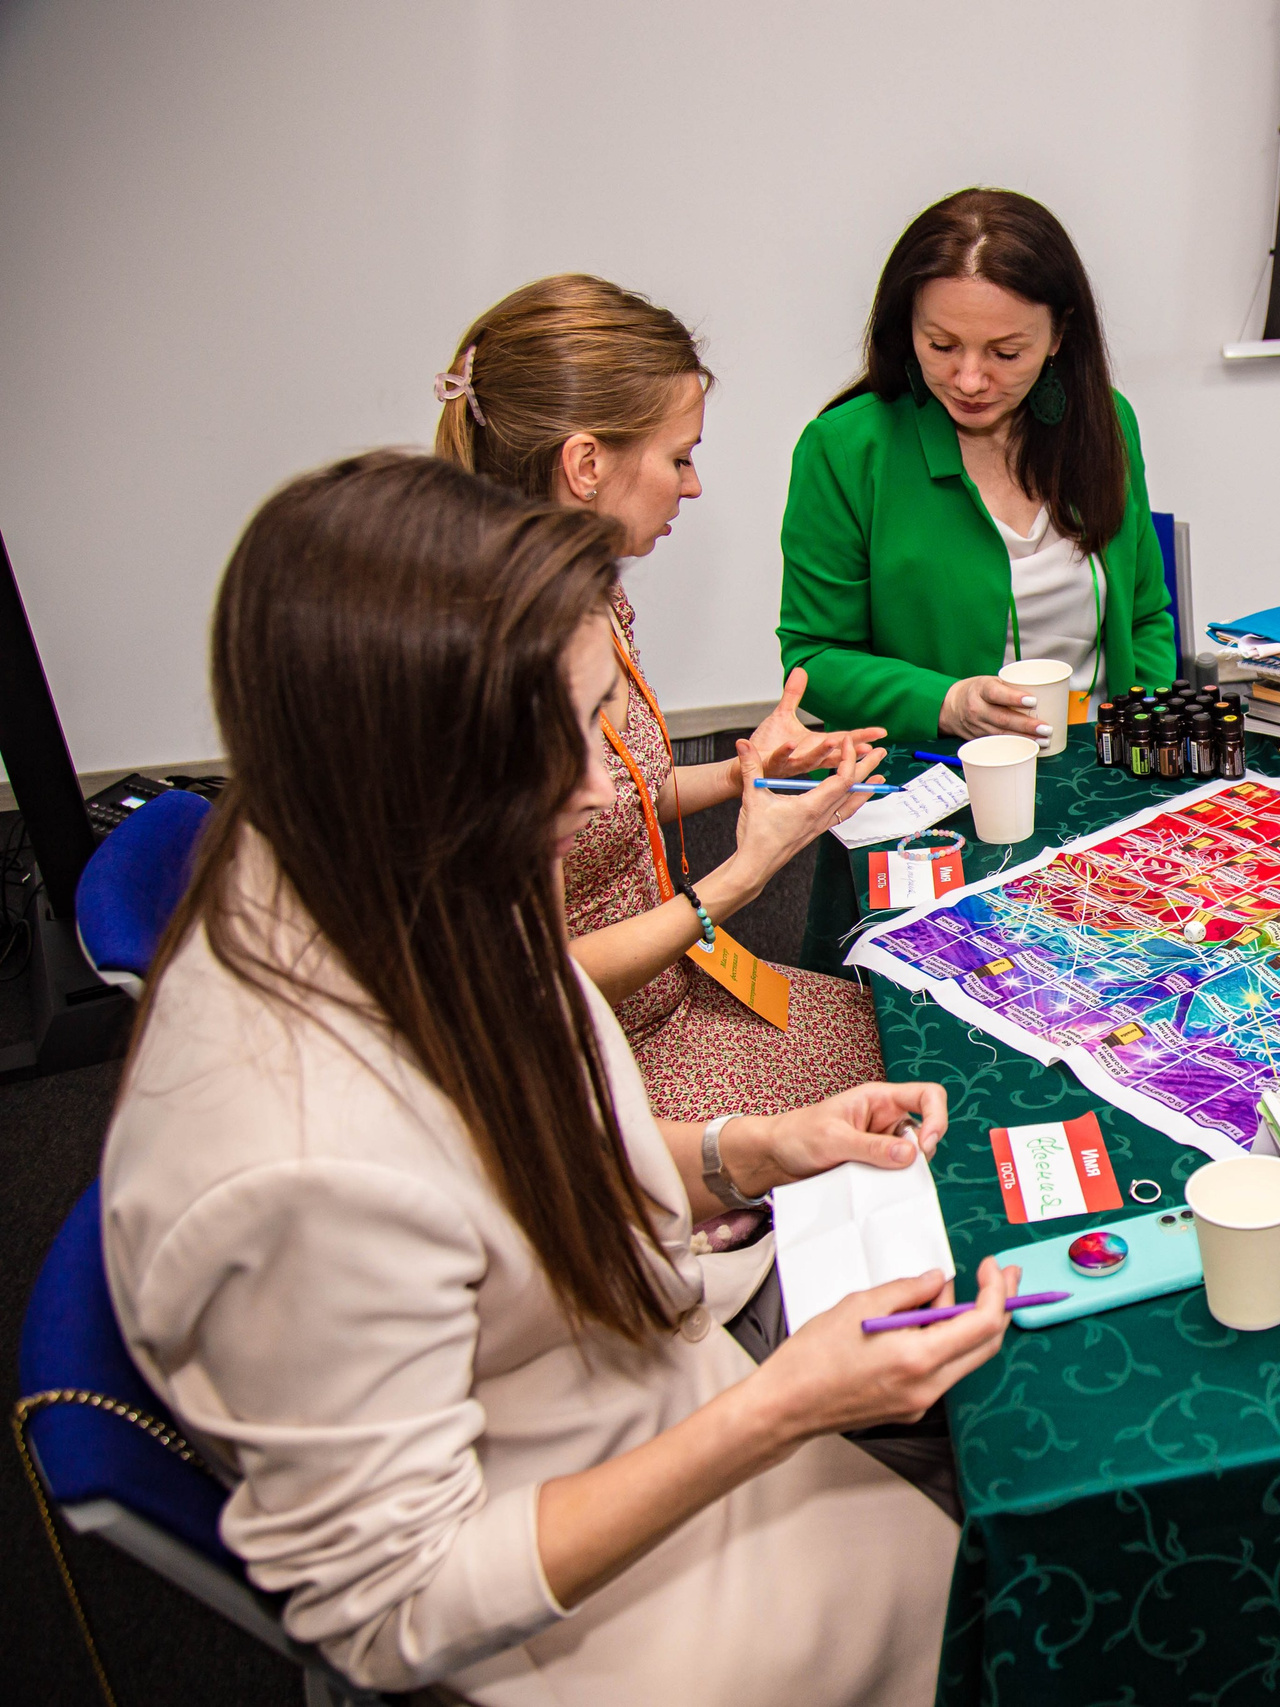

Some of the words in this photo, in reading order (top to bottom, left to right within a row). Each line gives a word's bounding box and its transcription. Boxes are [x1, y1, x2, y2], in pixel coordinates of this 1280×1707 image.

[1014, 951, 1048, 974] Негативны
[964, 982, 982, 996] План
[1207, 995, 1231, 1014] Земля
[1152, 1022, 1171, 1039] План
[1166, 1038, 1179, 1046] 58
[1095, 1050, 1114, 1068] План
[1098, 1045, 1130, 1075] Абсолюта
[1215, 1060, 1235, 1070] План
[1109, 1067, 1122, 1076] 69
[1139, 1084, 1177, 1103] Саттвагуна
[1227, 1128, 1243, 1136] 71
[1080, 1148, 1101, 1178] Имя
[1026, 1136, 1065, 1216] Ксения
